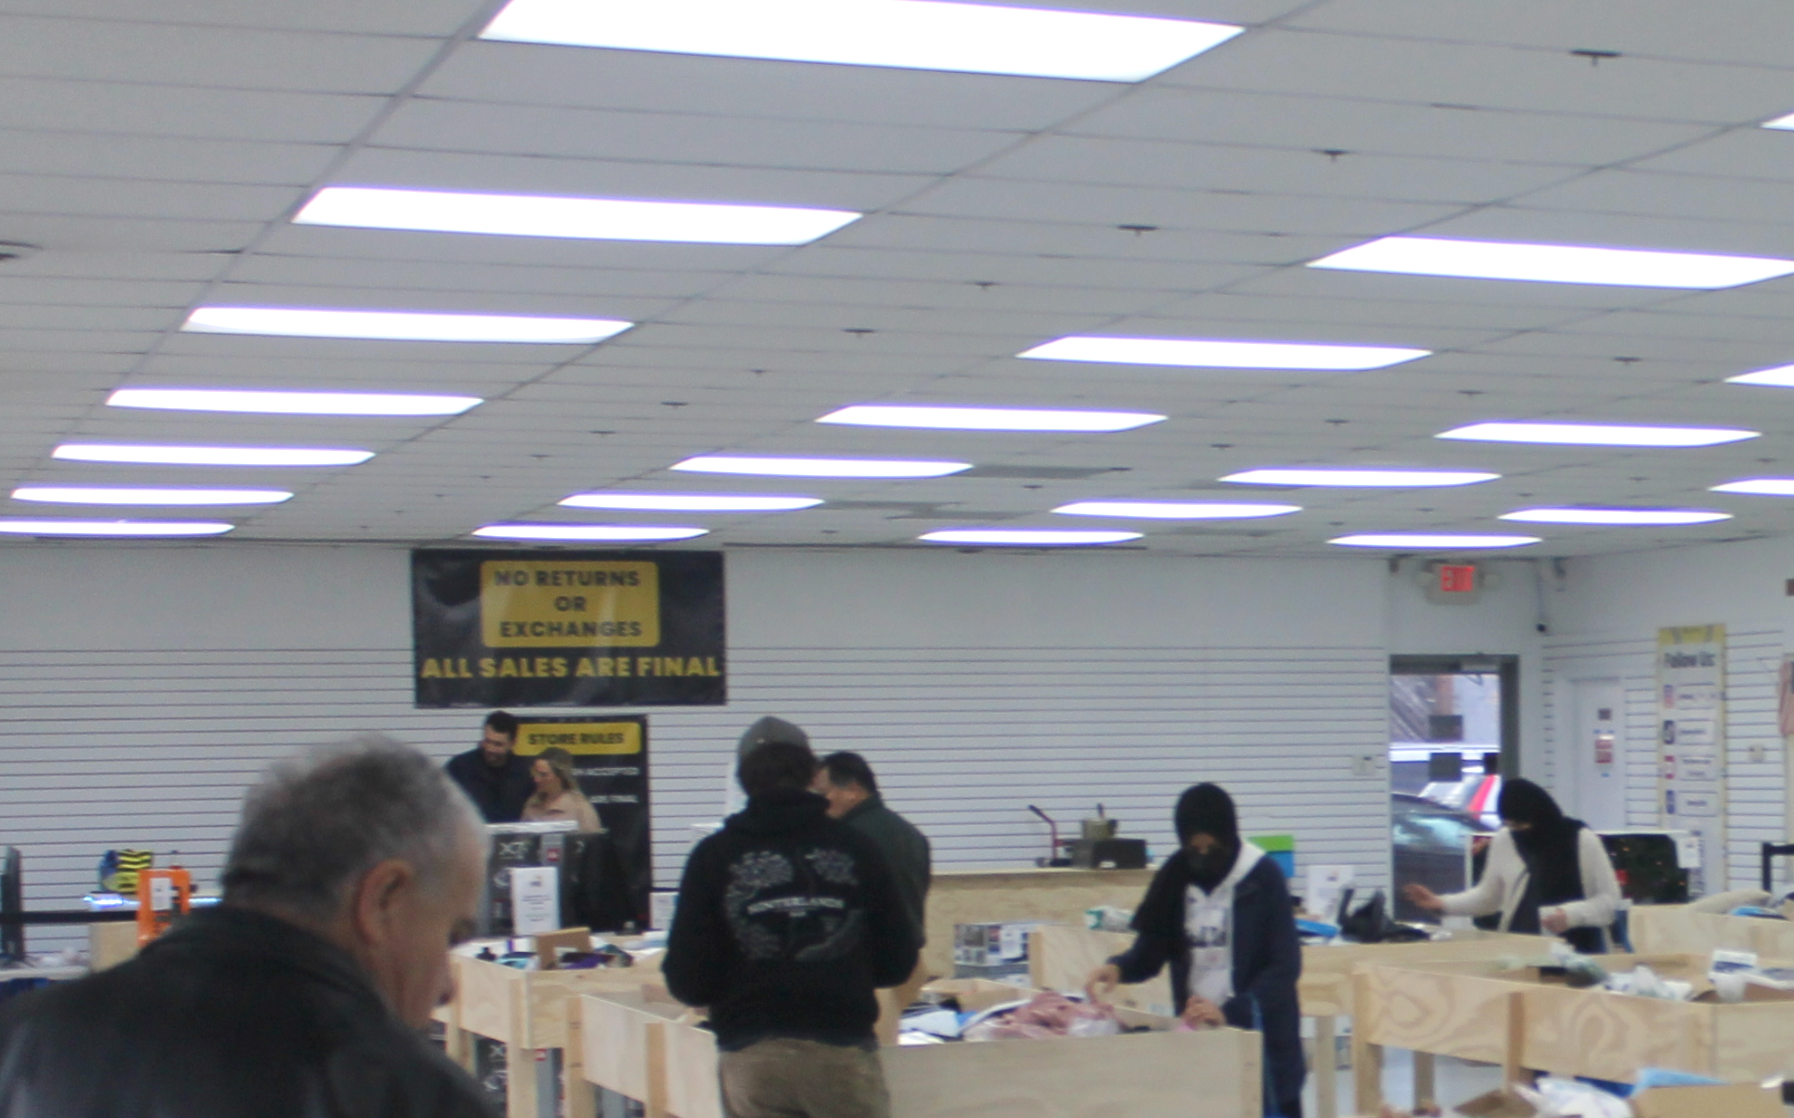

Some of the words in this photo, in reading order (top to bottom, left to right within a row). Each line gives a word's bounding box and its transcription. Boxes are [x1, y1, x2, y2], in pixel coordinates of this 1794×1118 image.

[494, 570, 529, 587] NO
[535, 570, 641, 587] RETURNS
[553, 595, 587, 613] OR
[499, 620, 643, 638] EXCHANGES
[420, 658, 473, 679] ALL
[478, 657, 569, 678] SALES
[574, 657, 633, 678] ARE
[639, 656, 721, 678] FINAL
[528, 732, 577, 745] STORE
[580, 732, 625, 744] RULES
